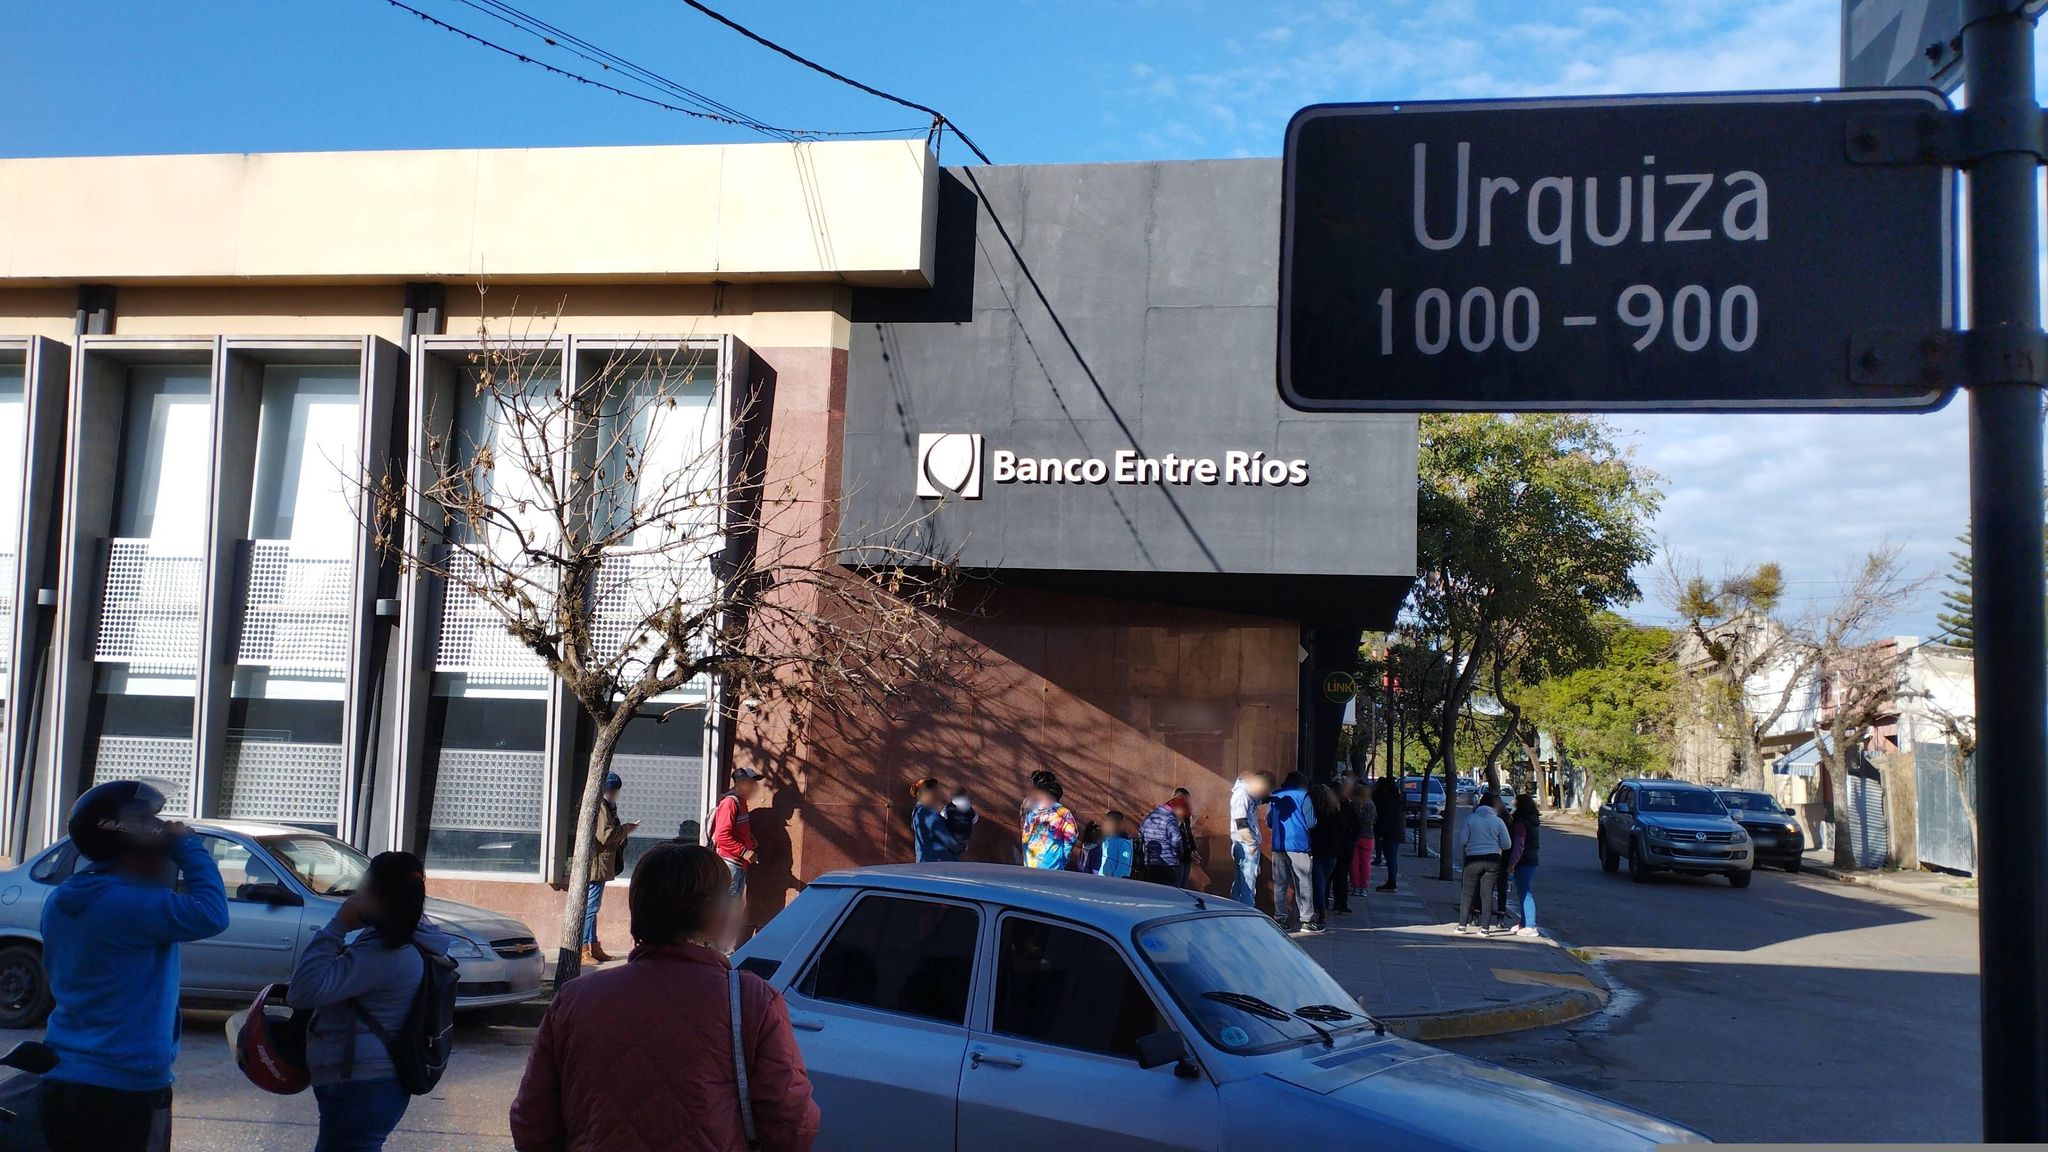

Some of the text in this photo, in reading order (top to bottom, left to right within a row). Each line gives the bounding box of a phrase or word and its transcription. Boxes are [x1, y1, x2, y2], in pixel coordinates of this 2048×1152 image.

[1412, 141, 1770, 265] Urquiza
[1376, 285, 1541, 356] 1000
[1616, 283, 1760, 354] 900
[993, 449, 1308, 484] Banco Entre Ríos
[1327, 680, 1354, 693] LINK
